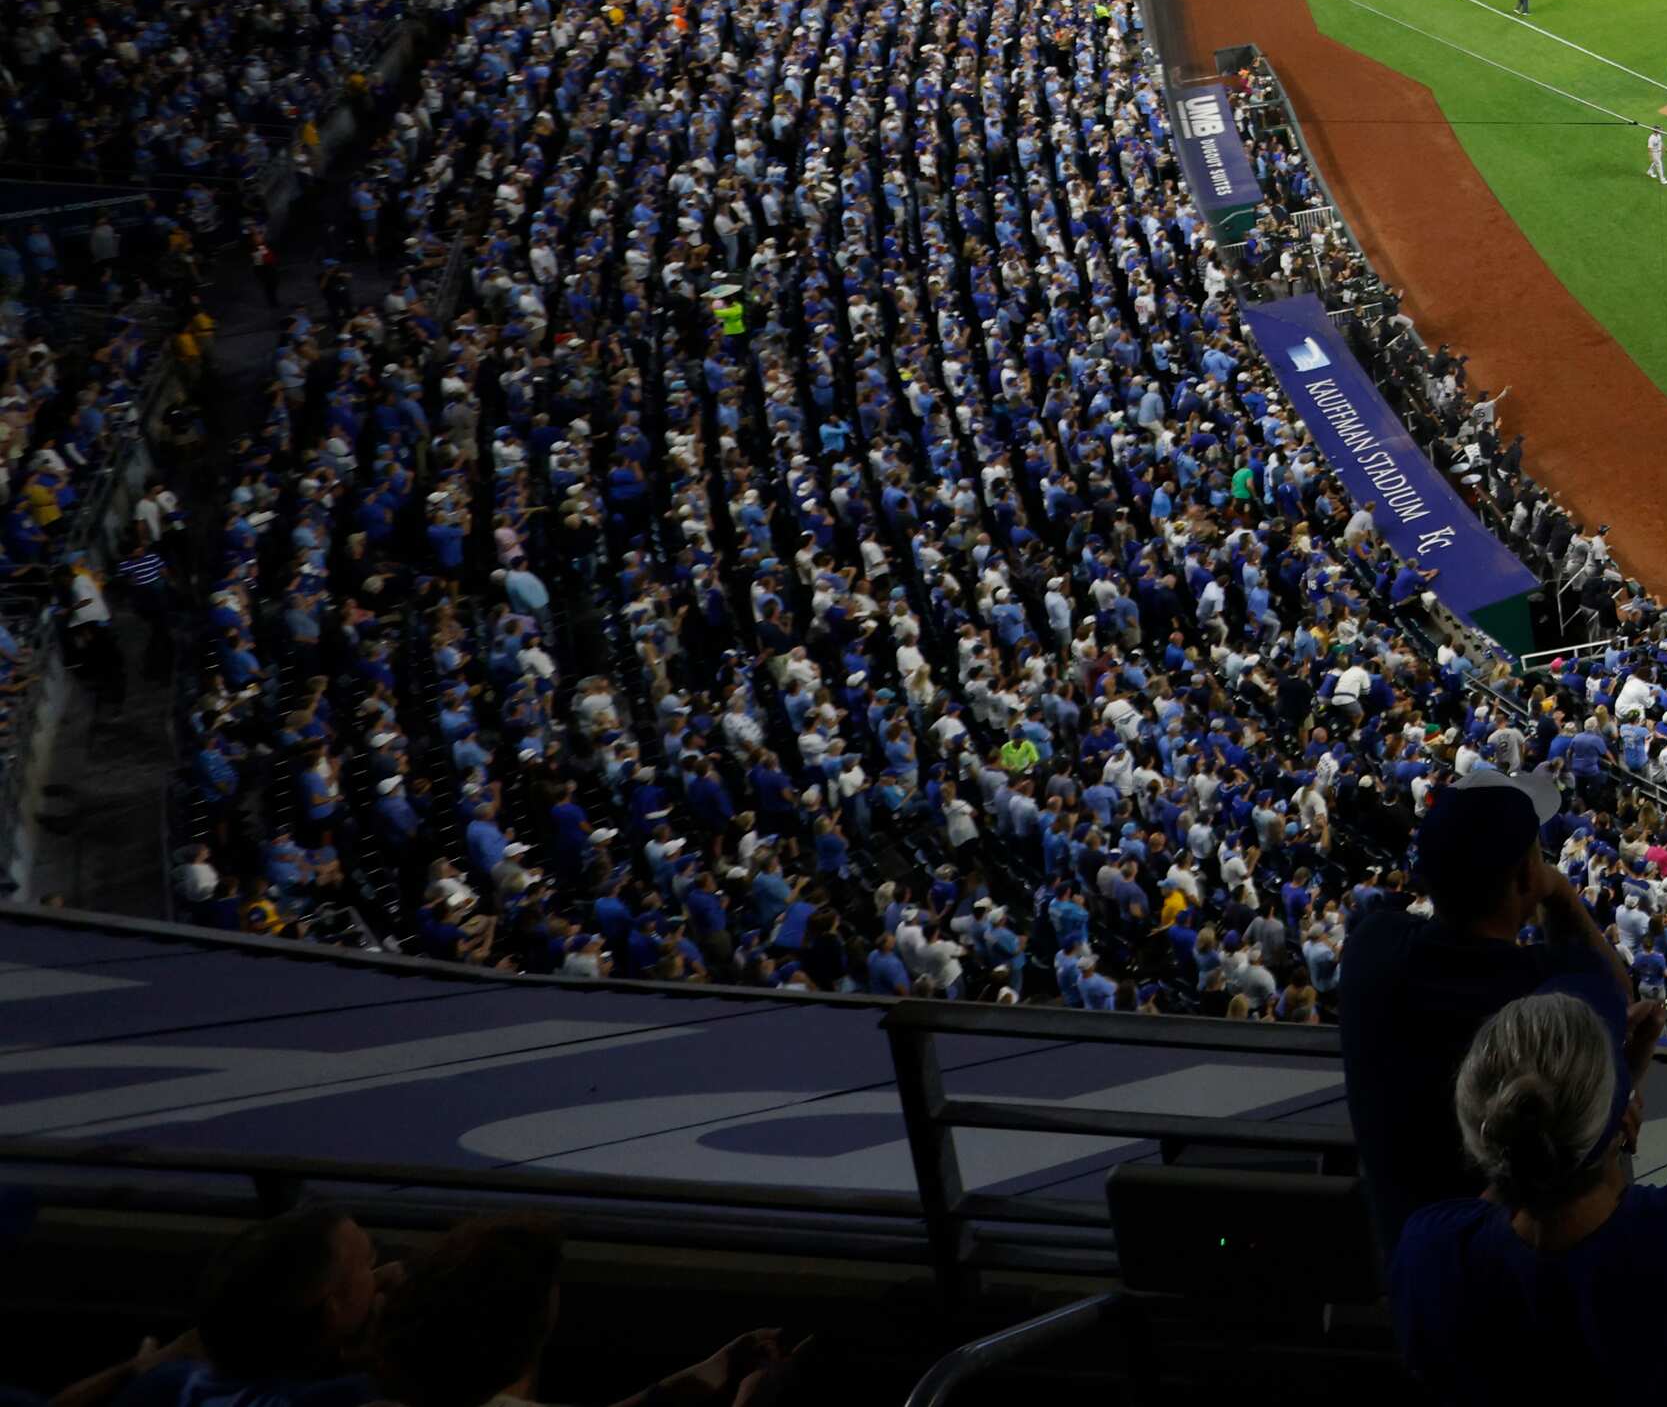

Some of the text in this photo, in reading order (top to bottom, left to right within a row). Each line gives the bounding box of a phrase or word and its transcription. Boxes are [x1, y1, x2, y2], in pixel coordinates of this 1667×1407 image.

[1185, 95, 1225, 137] UMB
[1200, 138, 1233, 196] DUGOUT SUITES
[1306, 378, 1456, 557] KAUFFMAN STADIUM KC
